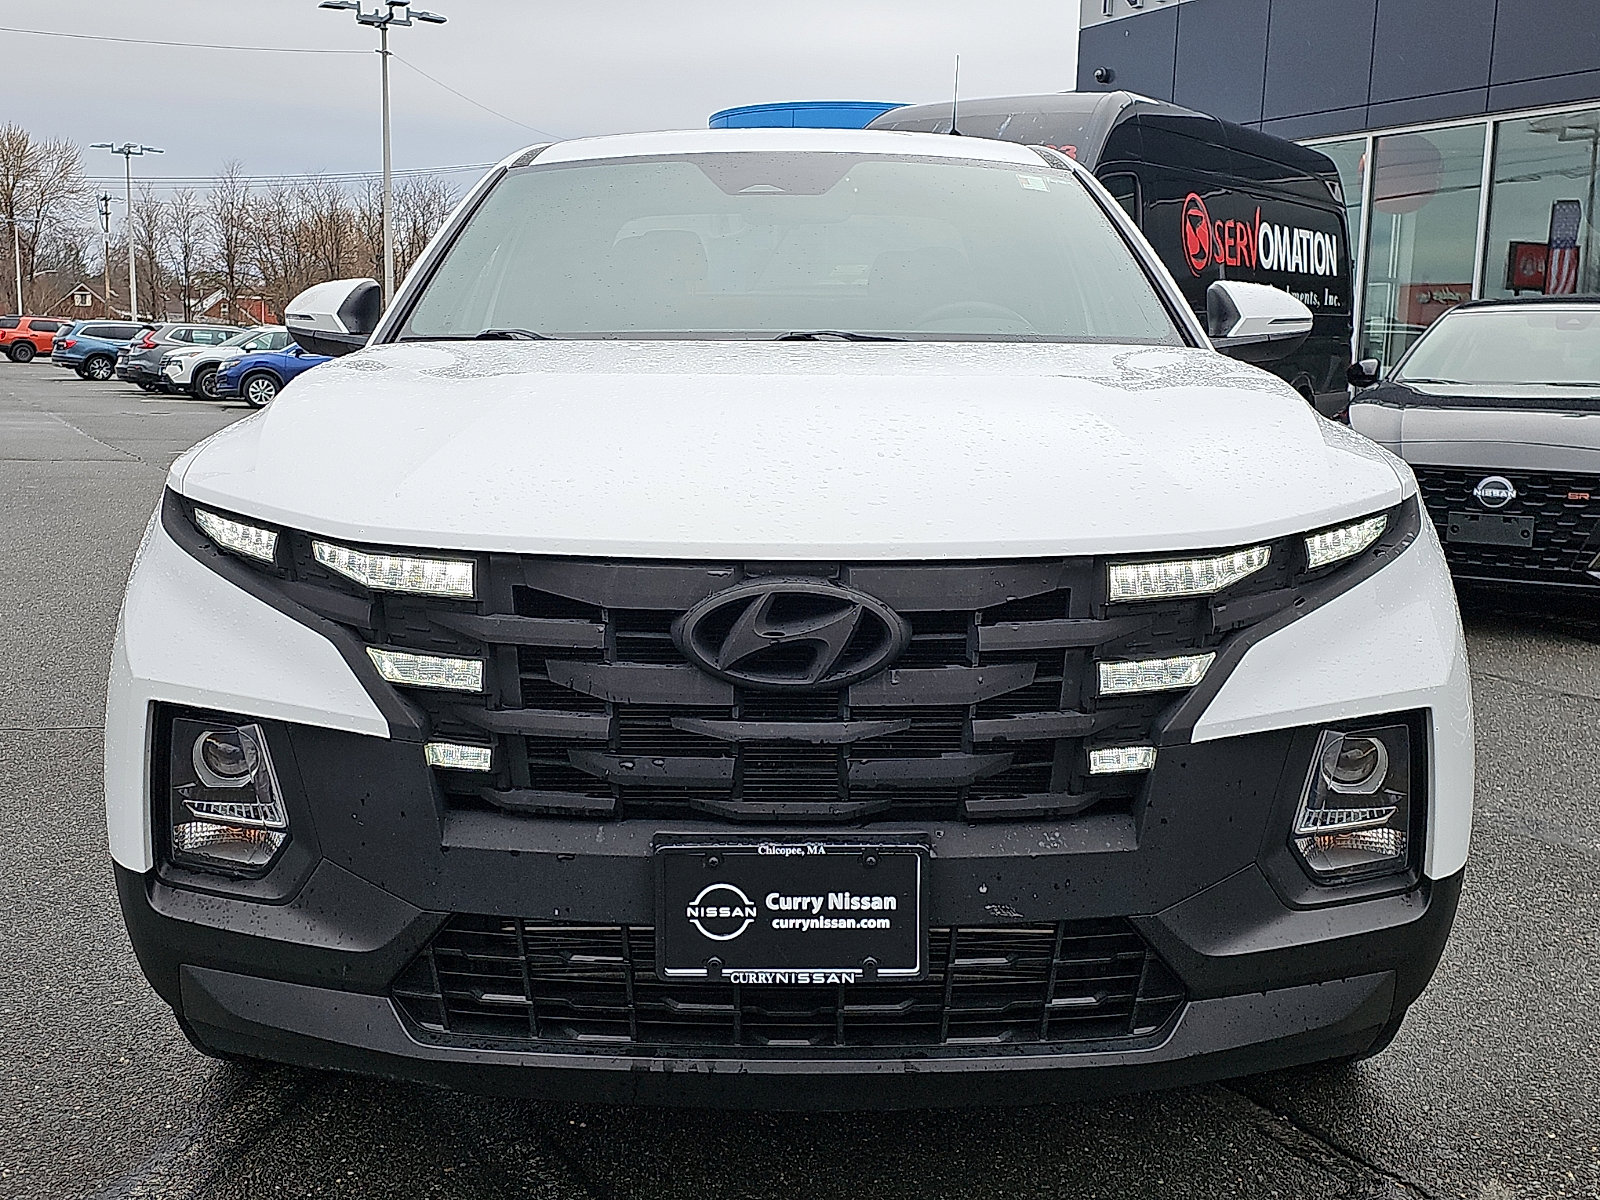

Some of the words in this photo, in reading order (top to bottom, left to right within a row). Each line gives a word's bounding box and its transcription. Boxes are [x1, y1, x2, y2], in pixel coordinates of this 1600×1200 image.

[1213, 206, 1338, 277] SERVOMATION
[1324, 287, 1341, 307] Inc.
[1473, 487, 1517, 499] NISSAN
[1567, 492, 1590, 501] SR
[757, 845, 806, 857] Chicopee,
[806, 845, 827, 855] MA
[765, 892, 824, 913] Curry
[828, 892, 897, 911] Nissan
[686, 906, 757, 918] NISSAN
[771, 915, 891, 932] currynissan.com
